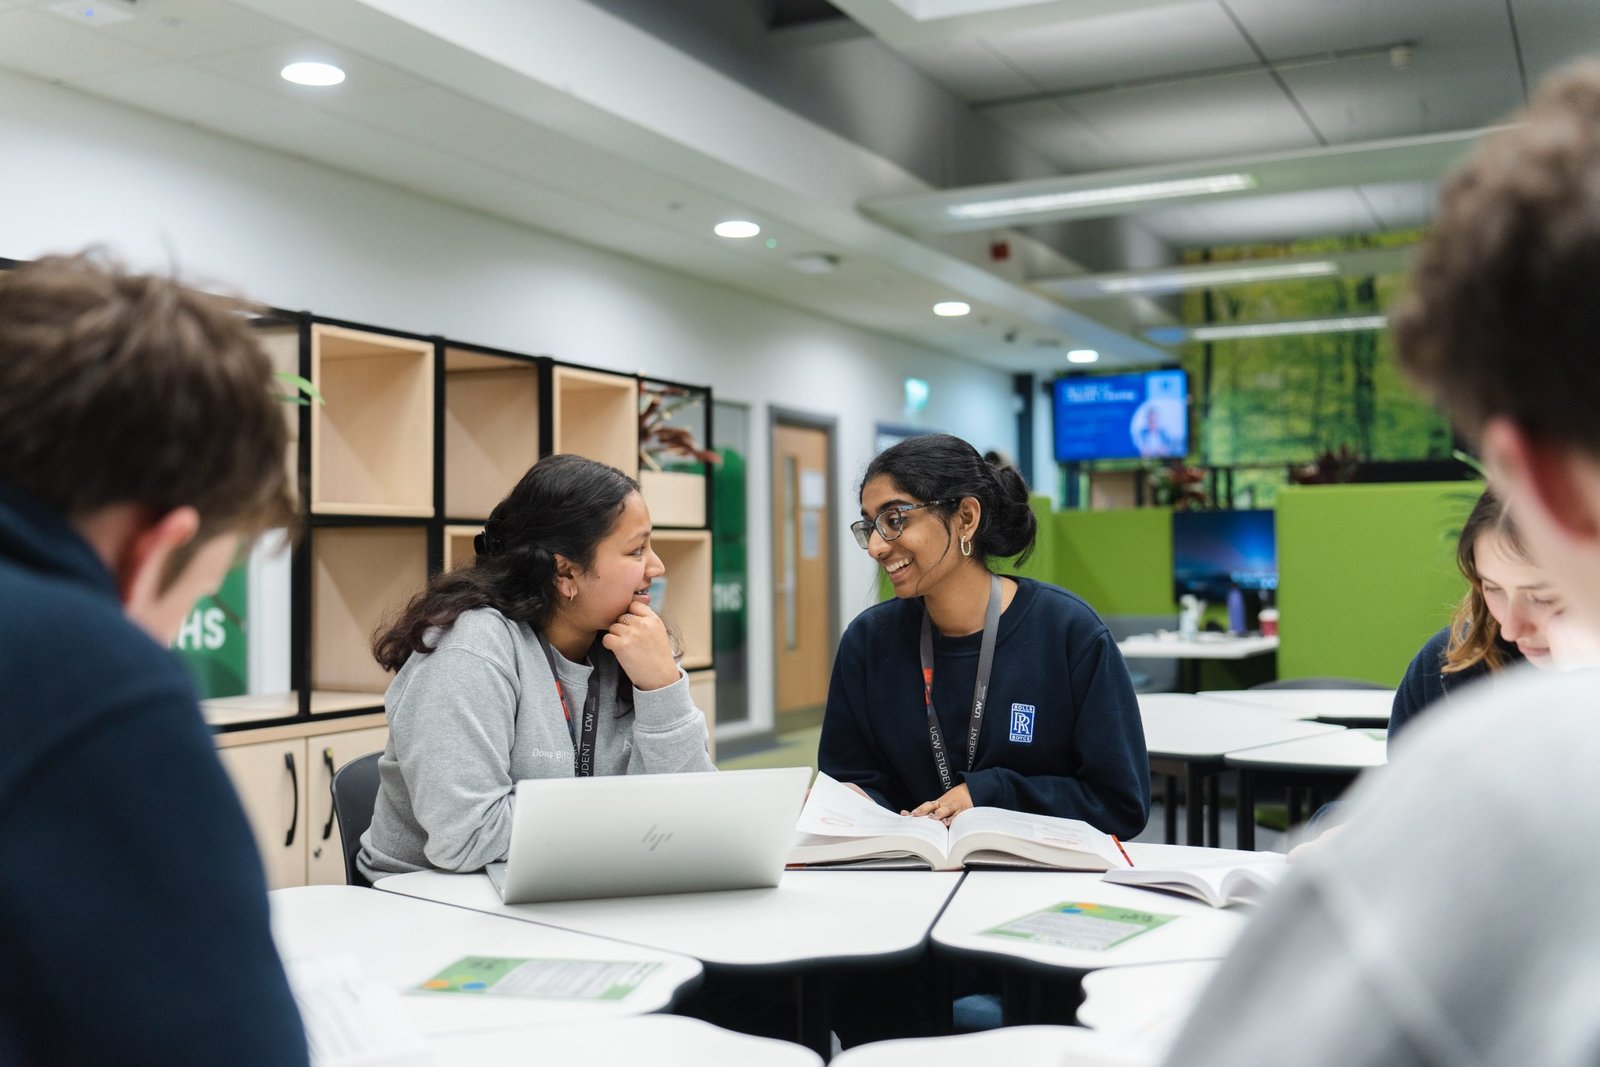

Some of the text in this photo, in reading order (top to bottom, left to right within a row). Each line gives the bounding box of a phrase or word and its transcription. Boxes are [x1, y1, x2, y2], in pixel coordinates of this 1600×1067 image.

[713, 583, 743, 611] HS
[177, 606, 227, 651] HS
[584, 713, 593, 732] UCW
[974, 700, 983, 718] UCW
[1013, 711, 1031, 735] RR
[581, 742, 590, 776] UDENT
[929, 726, 952, 790] UCW STUDEN
[641, 824, 674, 852] hp
